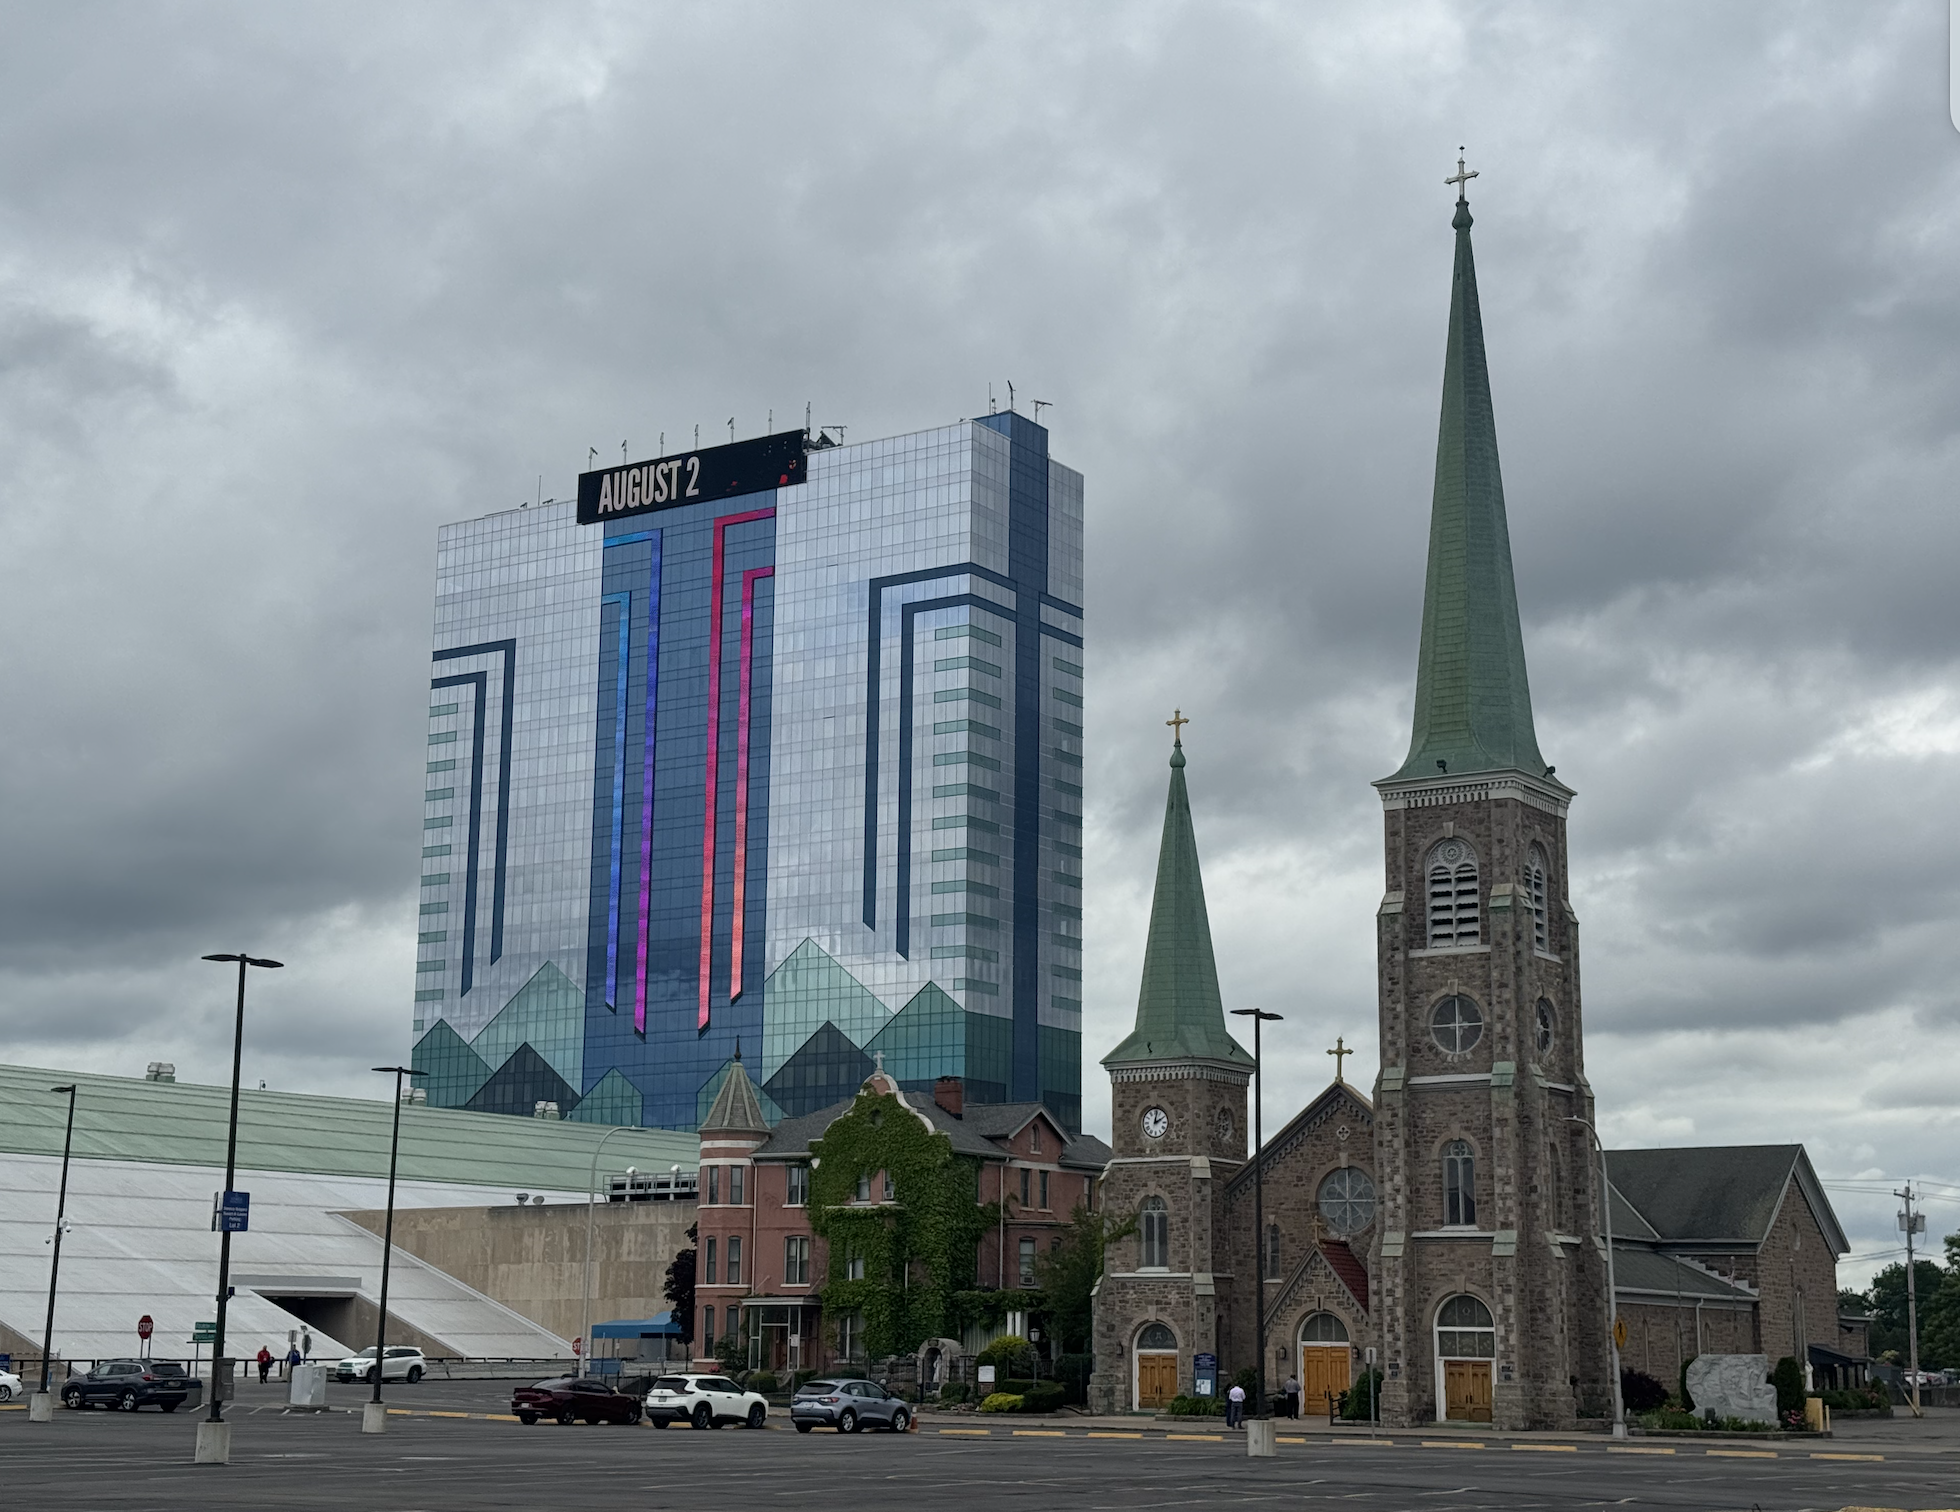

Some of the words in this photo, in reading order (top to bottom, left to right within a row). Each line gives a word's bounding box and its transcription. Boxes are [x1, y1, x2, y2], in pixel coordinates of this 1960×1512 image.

[598, 459, 682, 514] AUGUST
[685, 456, 700, 497] 2
[138, 1322, 153, 1332] STOP
